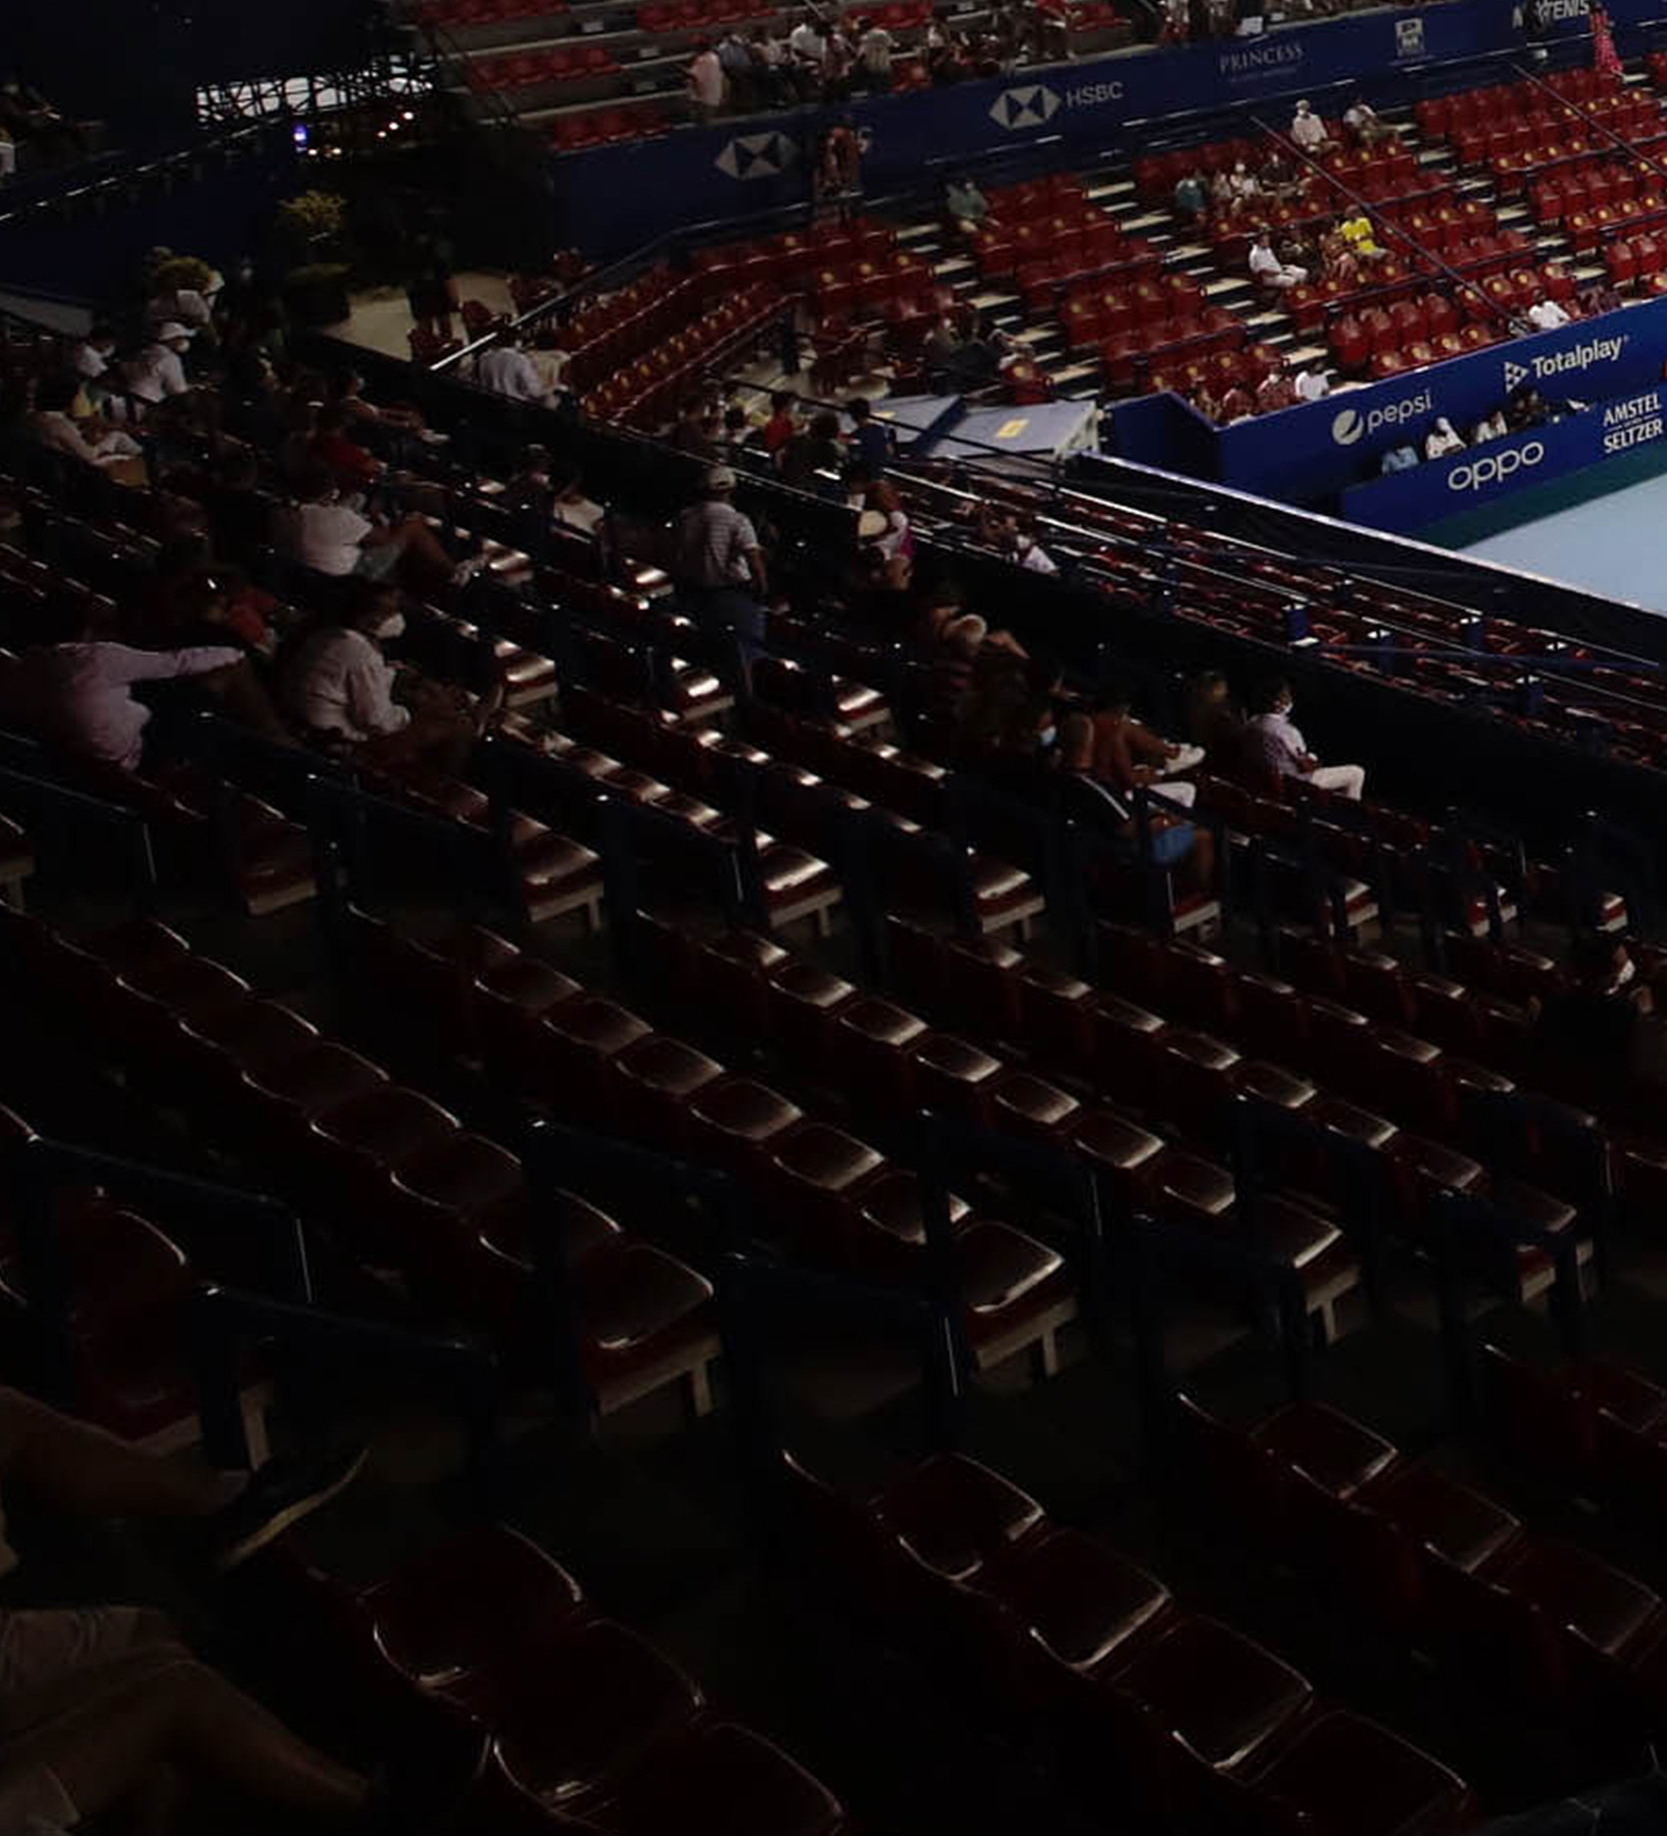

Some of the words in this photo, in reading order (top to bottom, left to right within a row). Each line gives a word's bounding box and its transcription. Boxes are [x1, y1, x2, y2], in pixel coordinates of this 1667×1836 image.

[1065, 81, 1125, 108] HSBC
[1531, 336, 1625, 379] Totalplay
[1366, 389, 1432, 434] pepsi
[1603, 392, 1663, 427] AMSTEL
[1603, 418, 1664, 454] SELTZER
[1447, 441, 1545, 491] oppo
